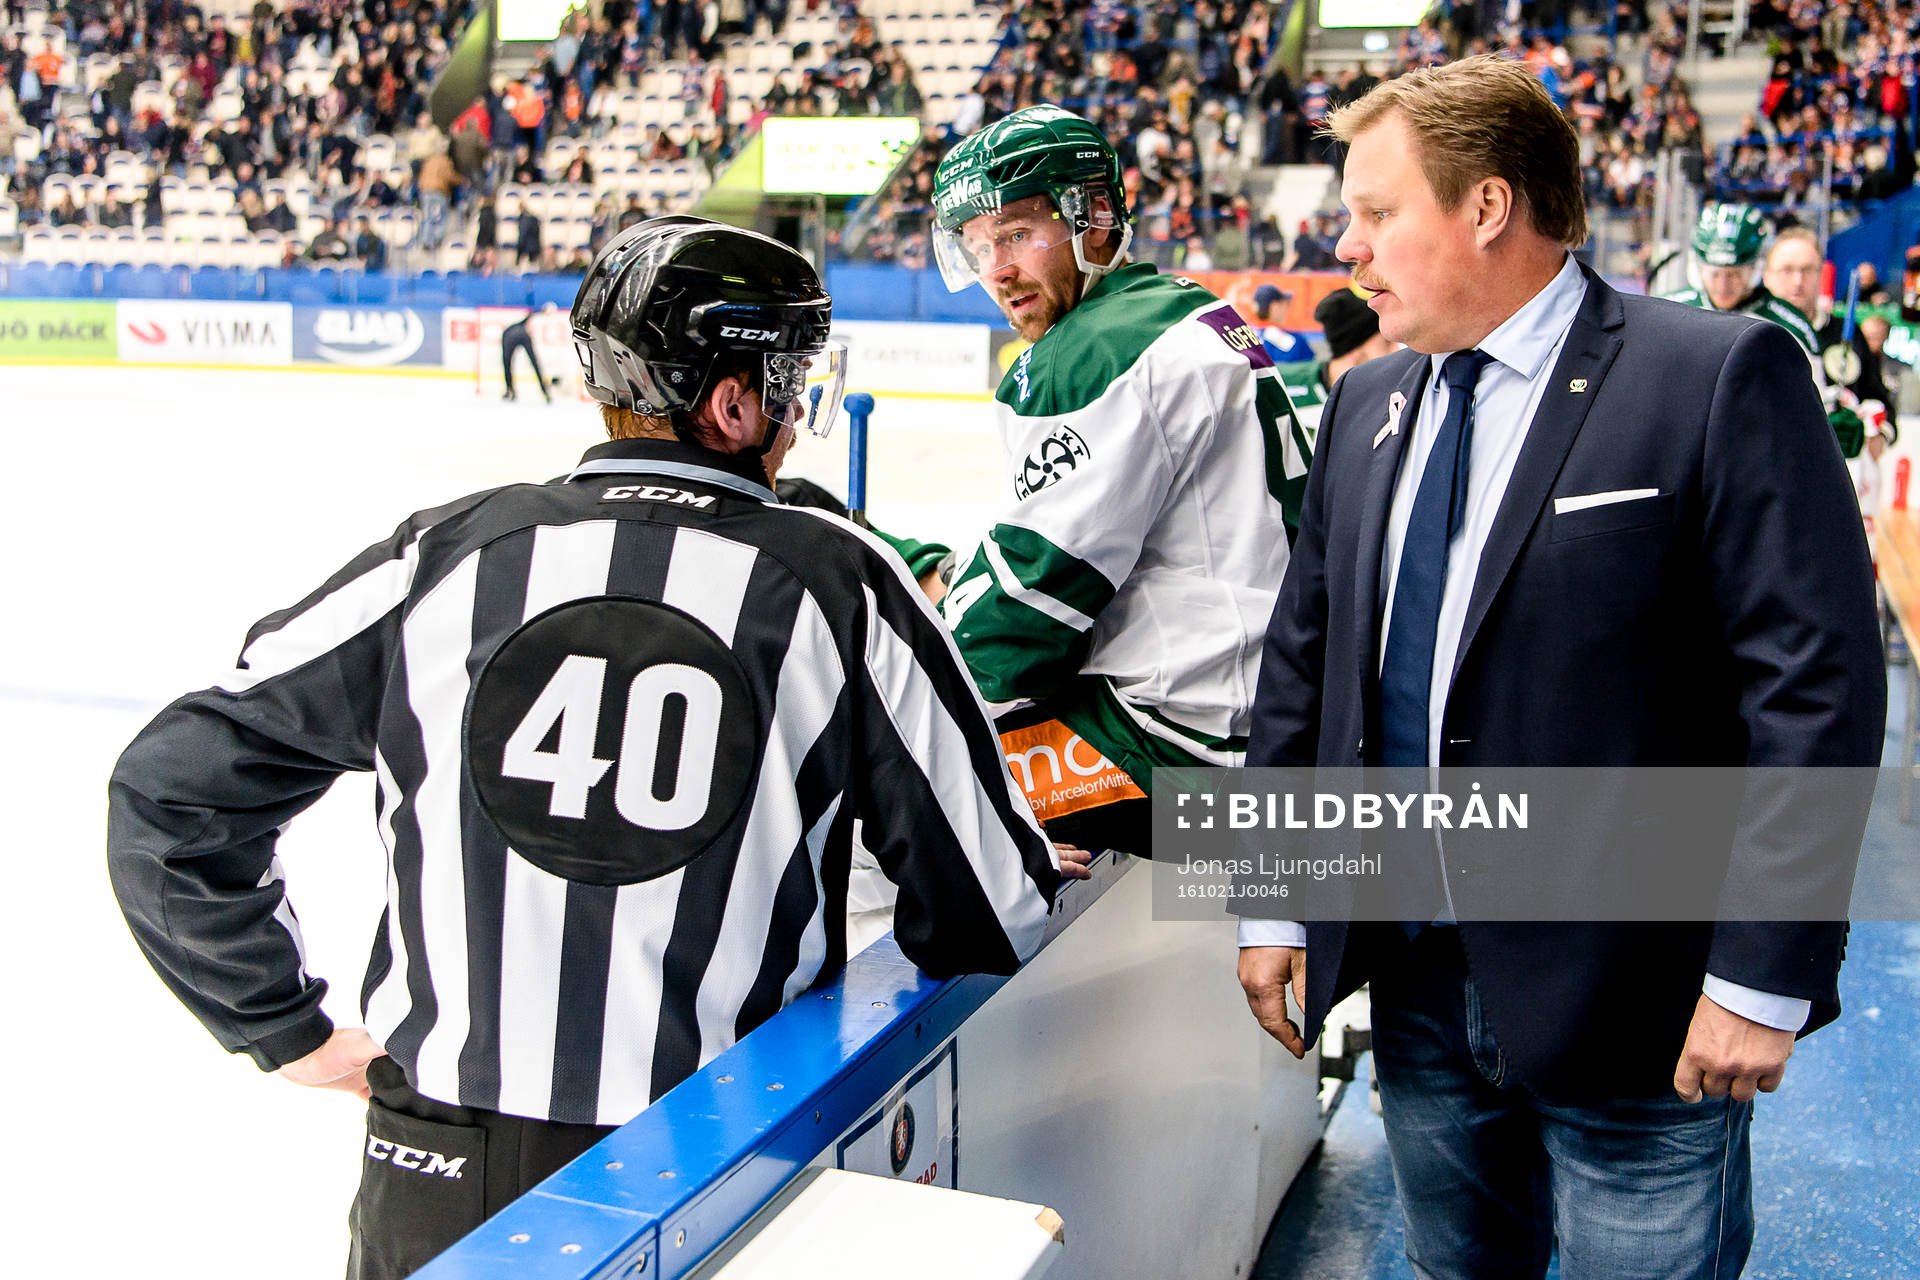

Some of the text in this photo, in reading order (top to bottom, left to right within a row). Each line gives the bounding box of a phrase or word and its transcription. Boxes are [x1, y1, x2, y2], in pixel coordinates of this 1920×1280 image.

[1076, 151, 1100, 159] CCM
[941, 158, 974, 183] CCM
[39, 319, 107, 341] DÄCK
[183, 320, 276, 346] VISMA
[720, 325, 780, 342] CCM
[602, 485, 716, 508] CCM
[501, 654, 723, 832] 40
[1028, 796, 1047, 811] by
[367, 1134, 467, 1178] CCM
